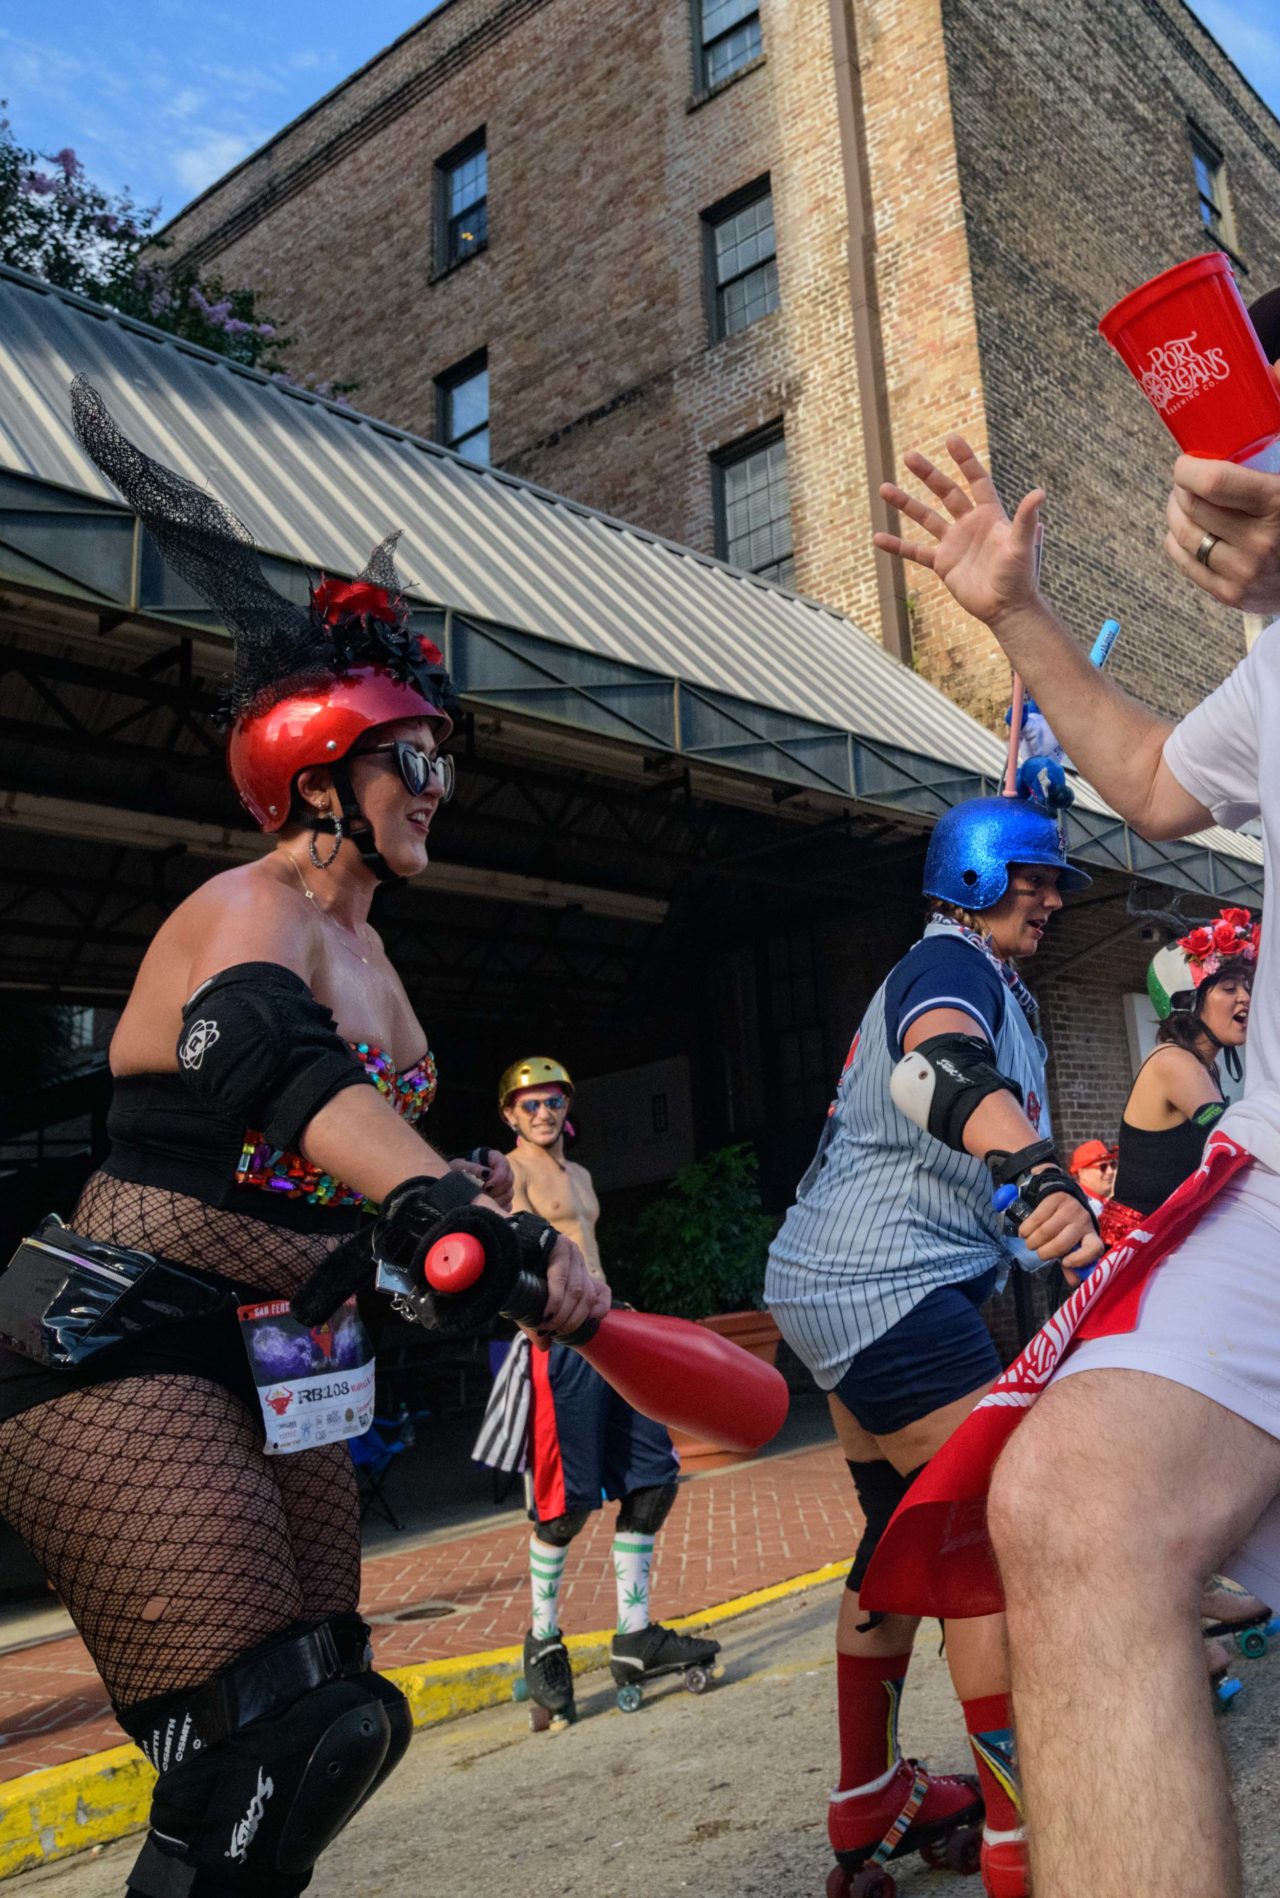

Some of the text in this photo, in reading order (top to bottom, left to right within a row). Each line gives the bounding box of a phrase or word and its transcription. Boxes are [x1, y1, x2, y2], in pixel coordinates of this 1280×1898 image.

[1147, 331, 1198, 377] PORT
[1137, 348, 1230, 413] ORLEANS
[297, 1381, 350, 1405] RB108
